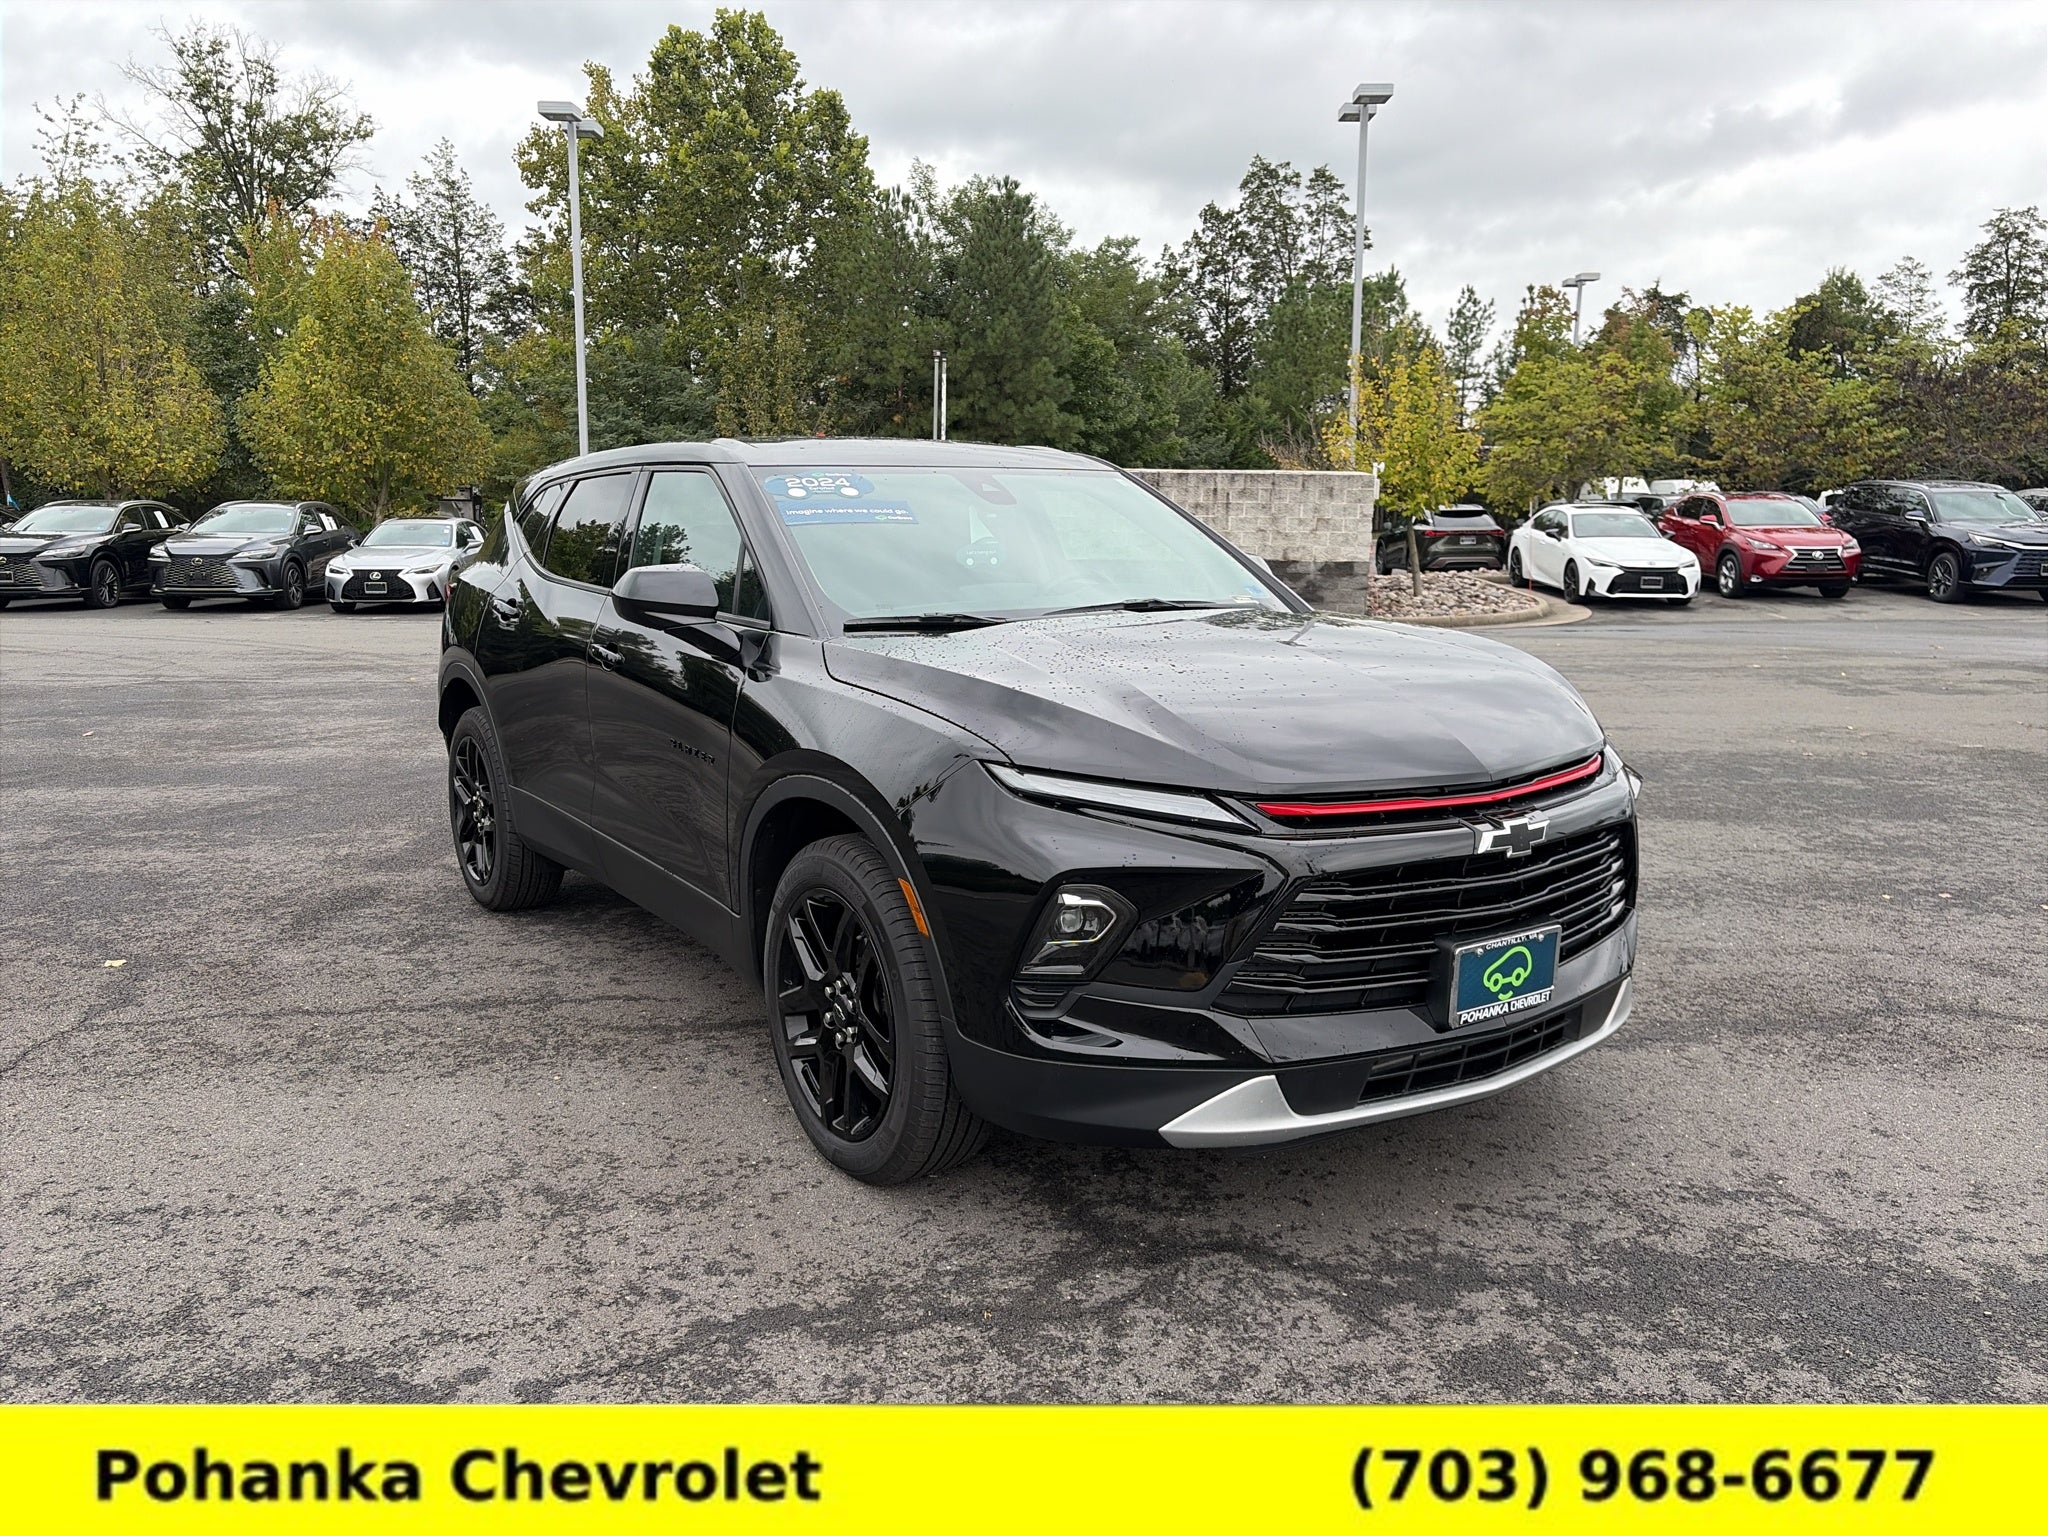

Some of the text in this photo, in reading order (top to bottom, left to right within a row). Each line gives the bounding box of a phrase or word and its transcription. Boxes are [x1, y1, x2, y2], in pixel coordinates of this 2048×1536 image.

[785, 477, 850, 487] 2024
[1460, 991, 1551, 1025] POHANKA CHEVROLET
